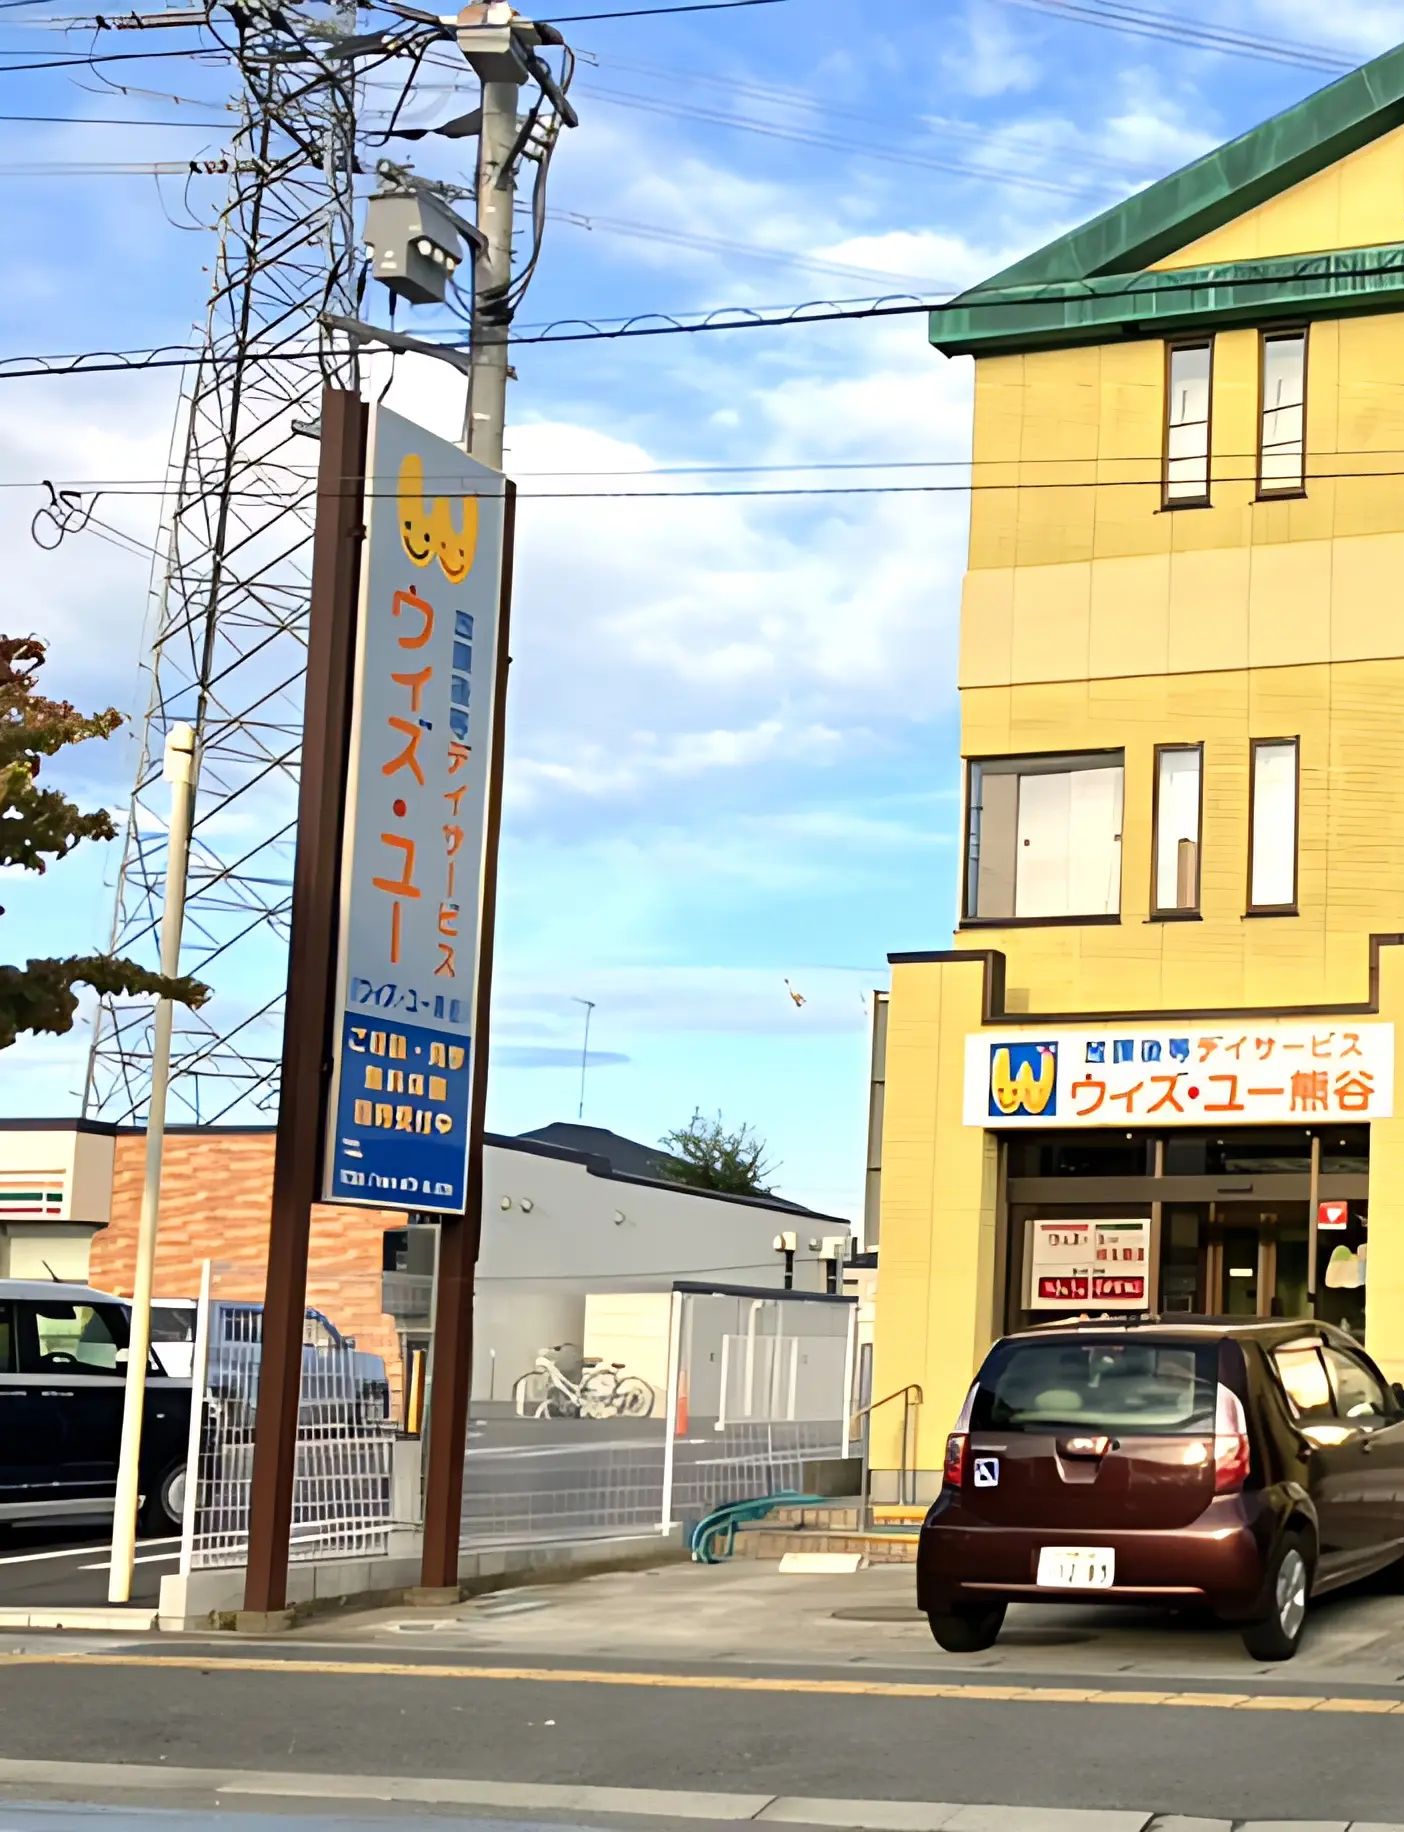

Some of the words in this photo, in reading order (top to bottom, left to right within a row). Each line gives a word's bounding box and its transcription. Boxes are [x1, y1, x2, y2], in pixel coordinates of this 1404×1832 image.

[433, 609, 475, 978] デイサービス
[1084, 1032, 1363, 1064] デイサービス
